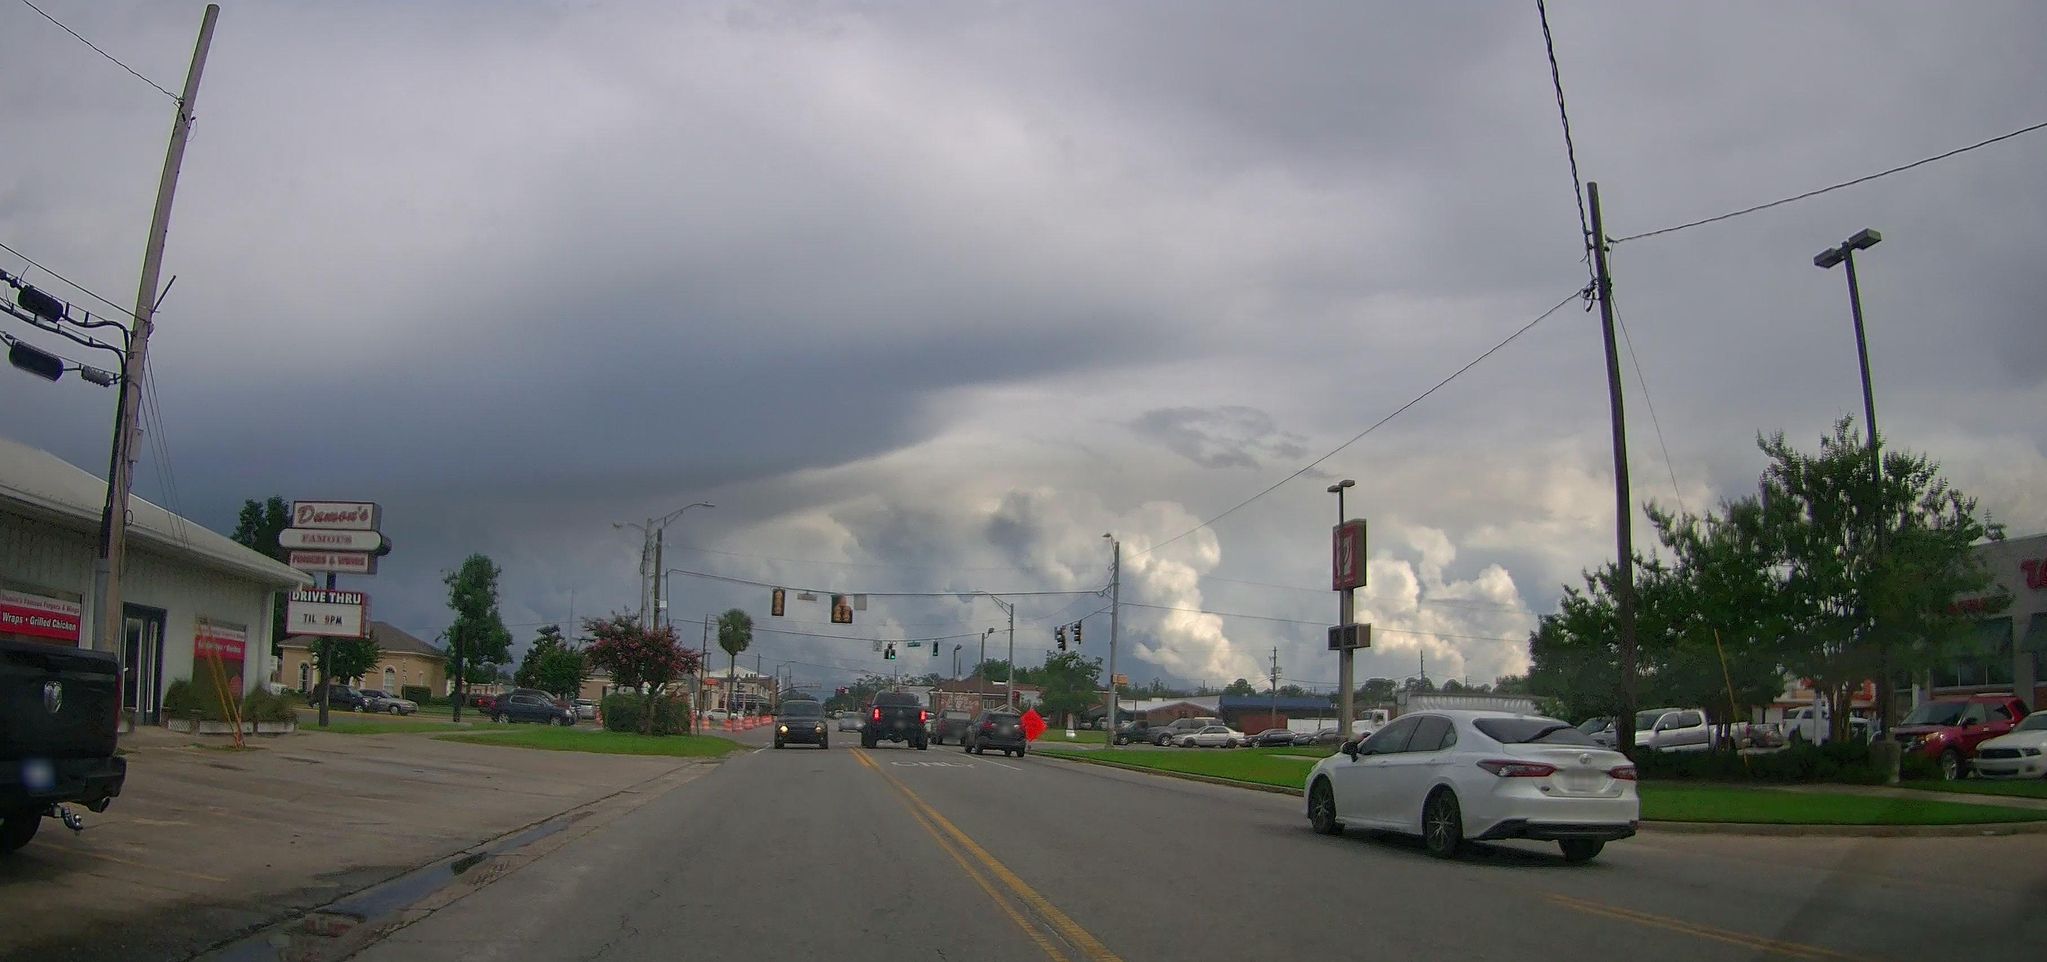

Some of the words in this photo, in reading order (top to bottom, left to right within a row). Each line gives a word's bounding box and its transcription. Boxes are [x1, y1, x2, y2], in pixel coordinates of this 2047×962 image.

[298, 504, 369, 524] Damon's
[301, 534, 352, 544] FAMOUS
[292, 590, 326, 602] DRIVE
[329, 592, 361, 604] THRU
[2, 611, 23, 625] Wraps
[30, 615, 51, 627] Grilled
[52, 618, 77, 631] Chicken
[304, 613, 316, 623] TIL
